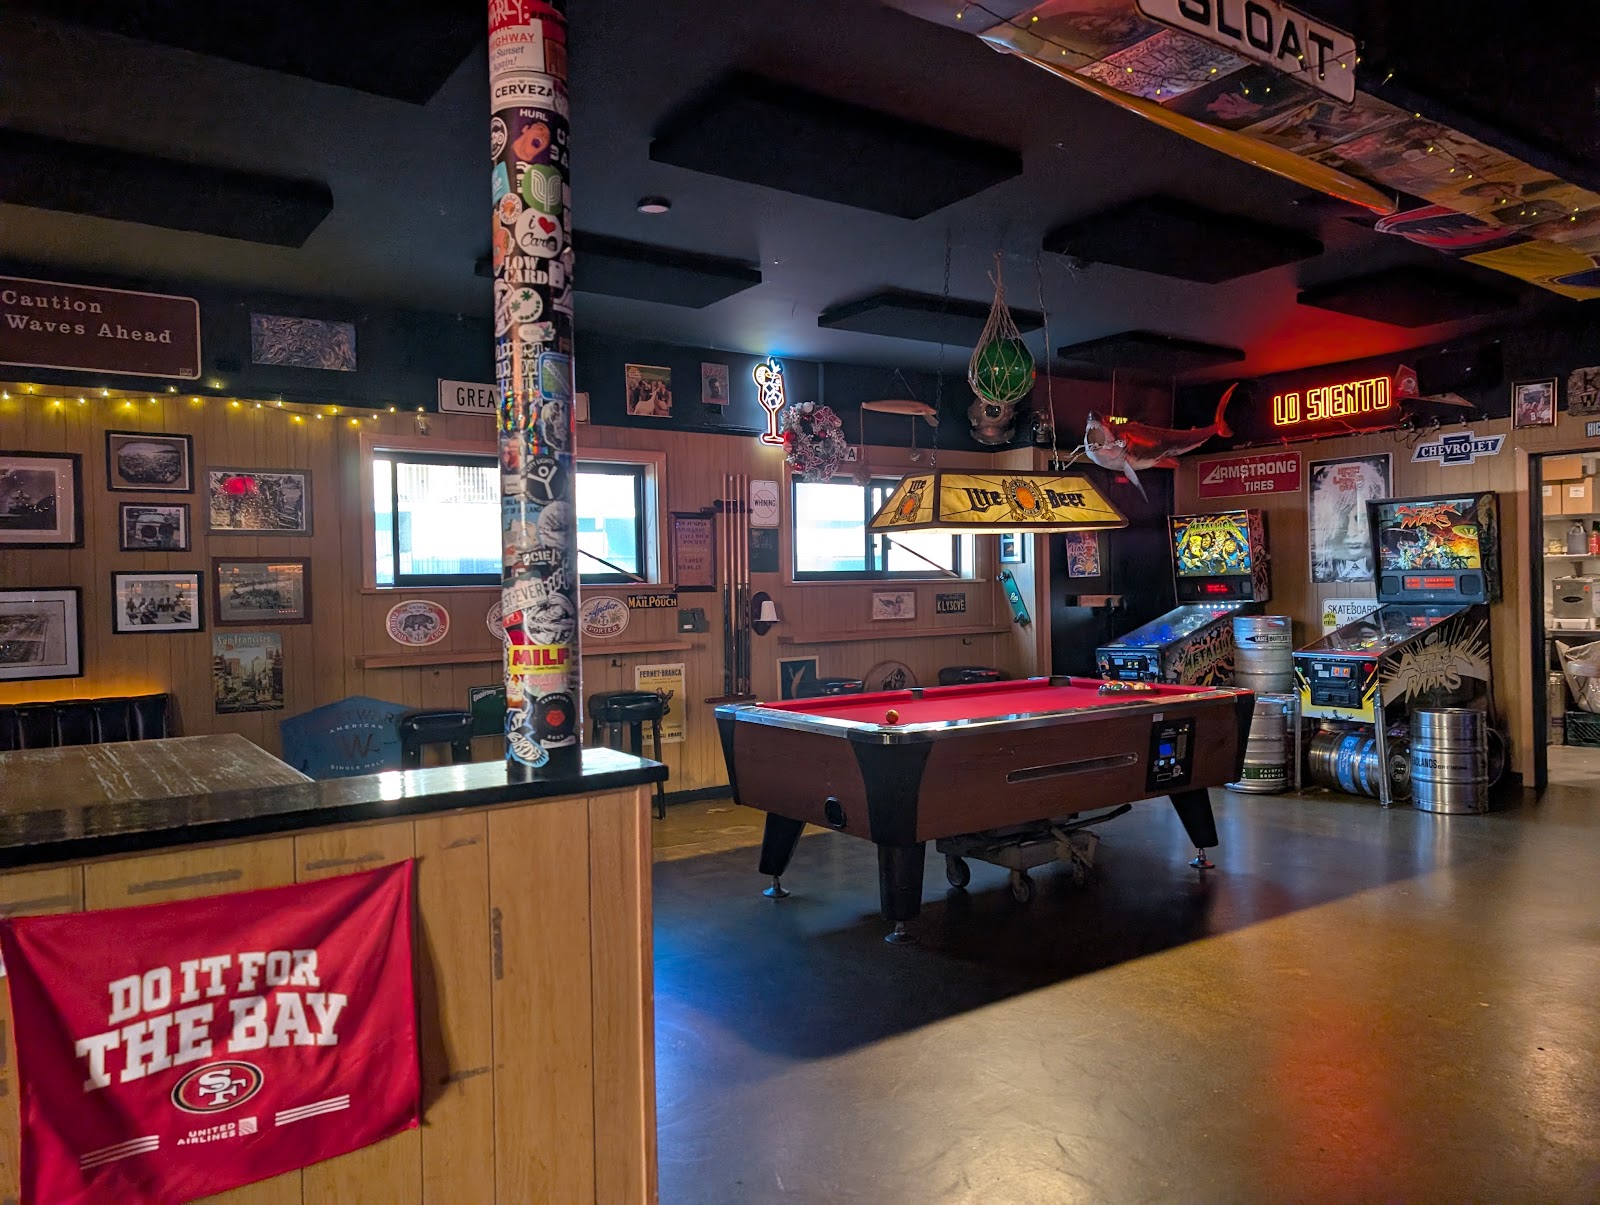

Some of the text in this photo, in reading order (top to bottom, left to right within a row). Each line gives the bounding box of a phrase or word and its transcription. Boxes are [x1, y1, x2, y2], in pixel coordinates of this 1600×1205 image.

[495, 84, 553, 98] CERVEZA
[519, 108, 549, 121] HURL
[504, 255, 540, 270] LOW
[503, 269, 549, 285] CARD
[1, 289, 102, 314] Caution
[5, 313, 172, 344] Waves Ahead
[1273, 376, 1391, 426] LO SIENTO
[1421, 439, 1496, 458] CHEVROLET
[1202, 460, 1297, 485] ARMSTRONG
[908, 480, 927, 493] Lite
[1244, 480, 1274, 493] TIRES
[754, 499, 776, 507] WHINING
[962, 487, 1004, 513] Lite
[1044, 489, 1086, 509] Beer
[1188, 519, 1238, 533] METALLICA
[1401, 514, 1452, 530] MARS
[628, 596, 677, 608] MAIL POUCH
[390, 611, 407, 640] CALIFORNIA
[431, 624, 446, 640] LAGER
[588, 624, 619, 634] PORTER
[1405, 664, 1462, 703] MARS
[329, 722, 384, 734] AMERICAN
[364, 759, 385, 769] MALT
[108, 949, 321, 1026] DO IT FOR
[75, 992, 348, 1094] THE BAY
[176, 1130, 236, 1146] AIRLINES
[187, 1122, 236, 1138] UNITED
